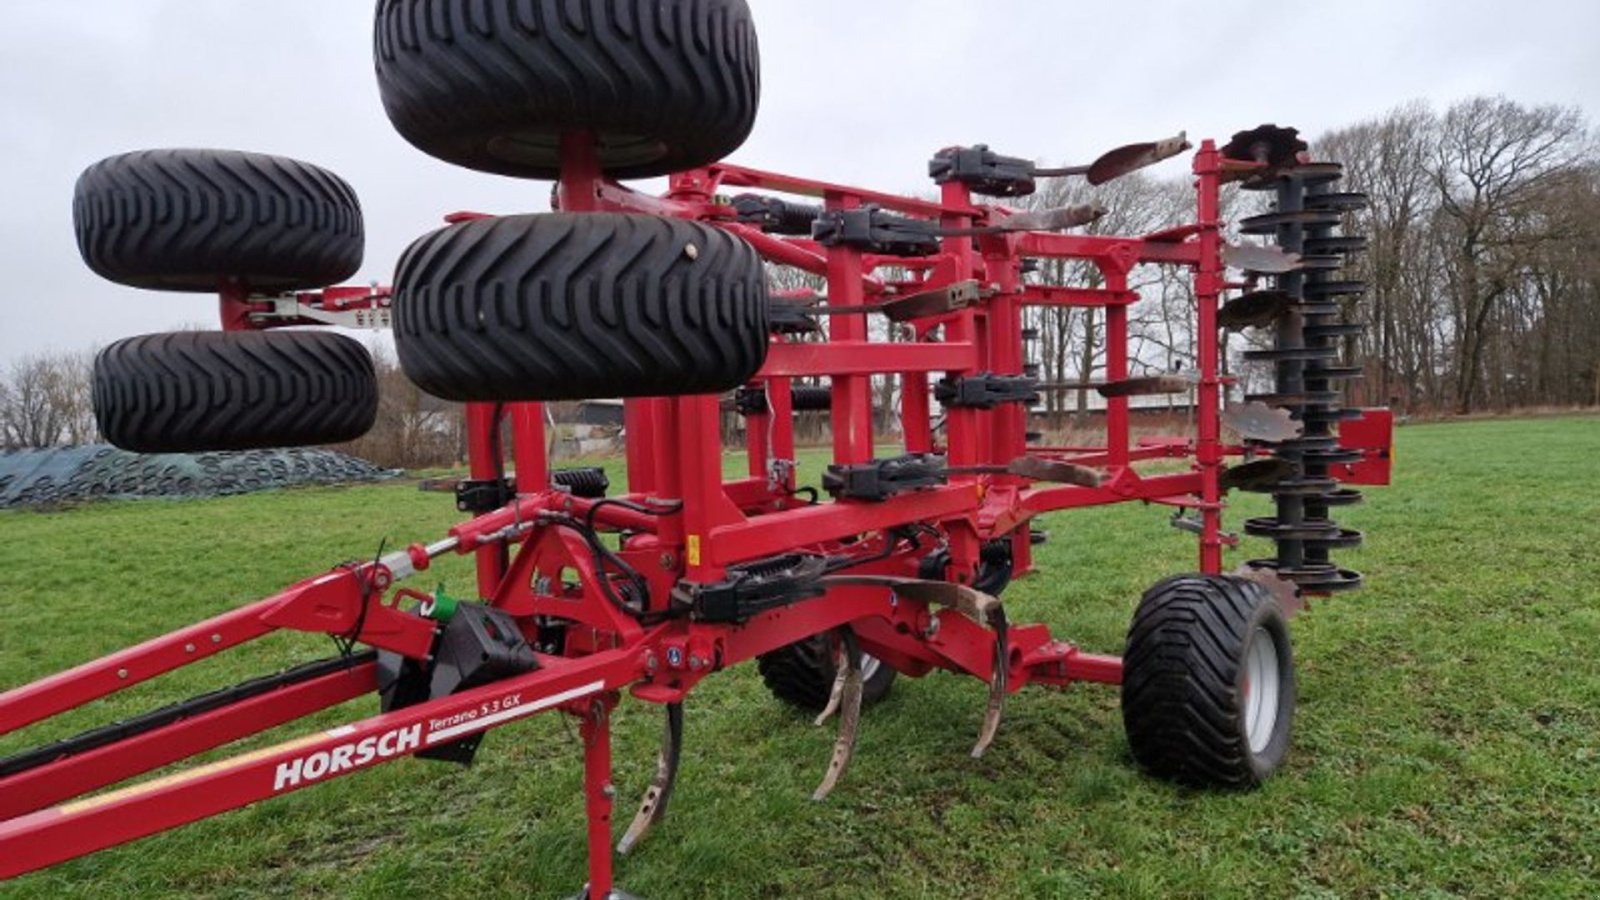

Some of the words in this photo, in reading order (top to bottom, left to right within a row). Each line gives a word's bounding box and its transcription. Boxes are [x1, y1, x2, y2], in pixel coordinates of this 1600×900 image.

[430, 709, 478, 731] Terrano
[502, 694, 521, 708] GX
[274, 723, 421, 790] HORSCH
